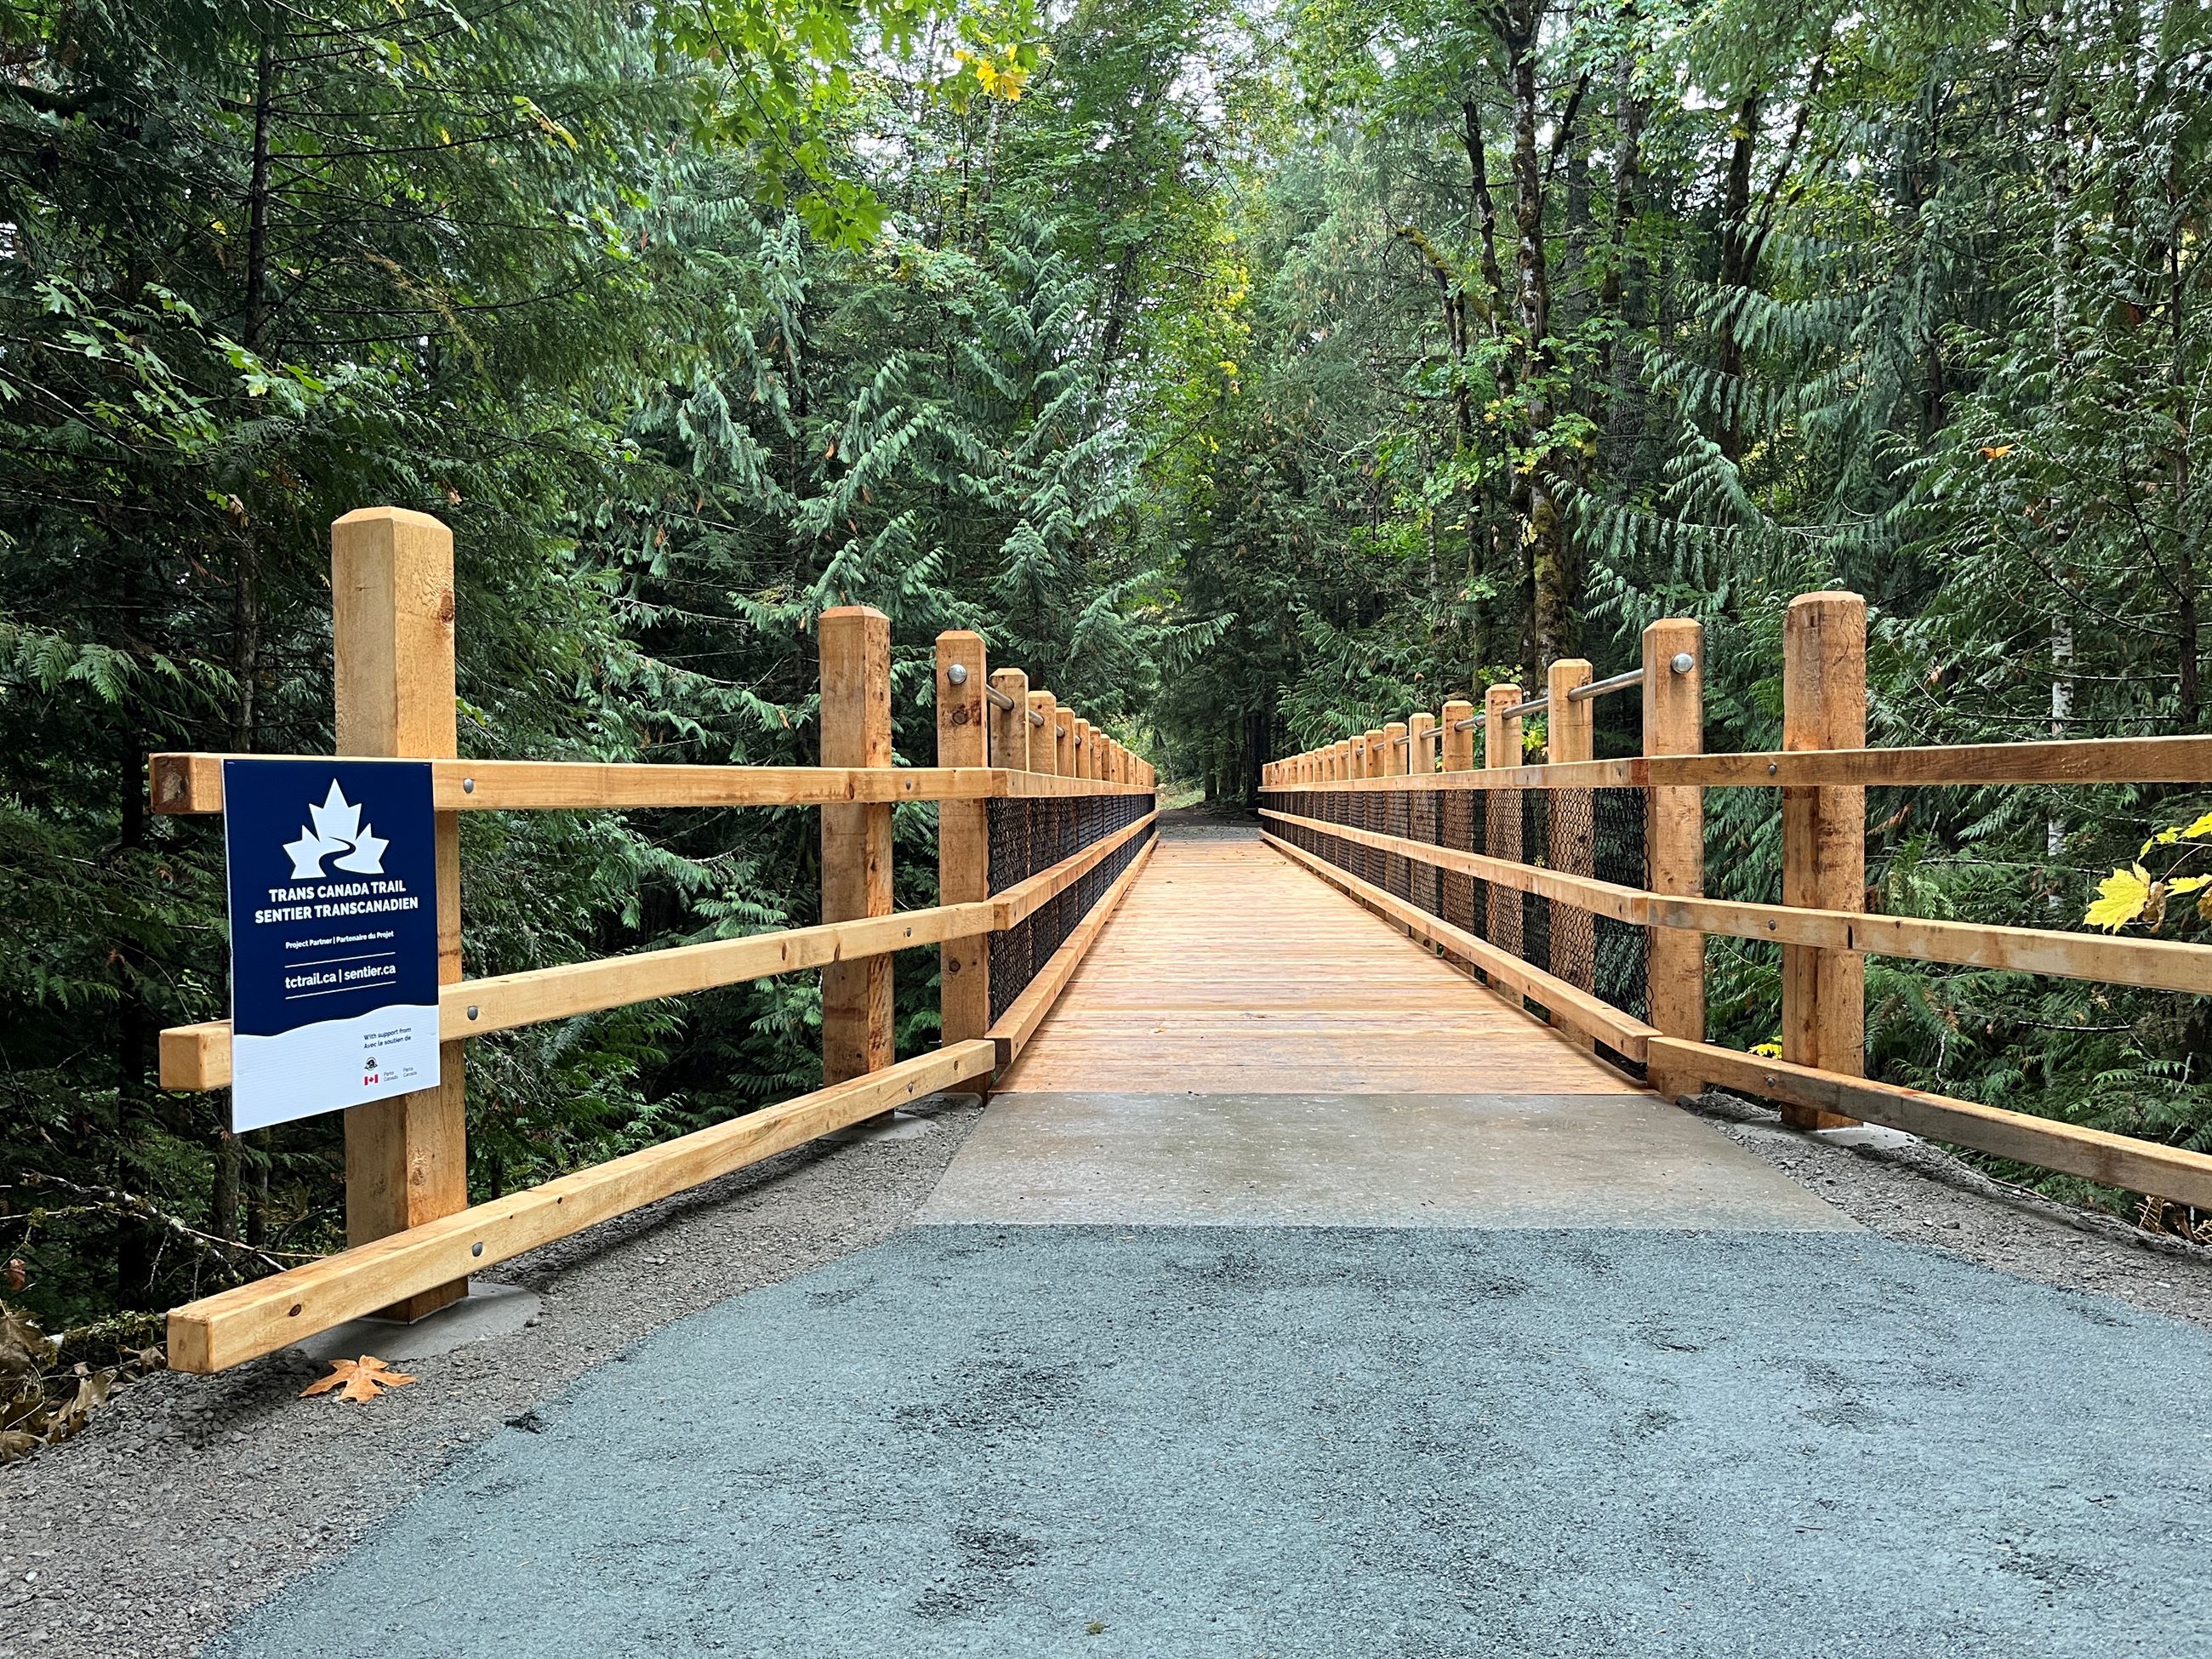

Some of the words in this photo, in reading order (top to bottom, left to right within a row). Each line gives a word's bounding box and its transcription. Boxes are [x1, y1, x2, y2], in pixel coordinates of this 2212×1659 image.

[269, 887, 314, 902] TRANS
[317, 883, 369, 898] CANADA
[371, 881, 406, 893] TRAIL
[255, 906, 312, 923] SENTIER
[314, 897, 419, 918] TRANSCANADIEN
[286, 940, 309, 949] Project
[310, 938, 332, 946] Partner
[336, 934, 367, 943] Partenaire
[285, 972, 336, 989] tctrail.ca
[345, 965, 396, 980] sentier.ca
[378, 1029, 398, 1038] support
